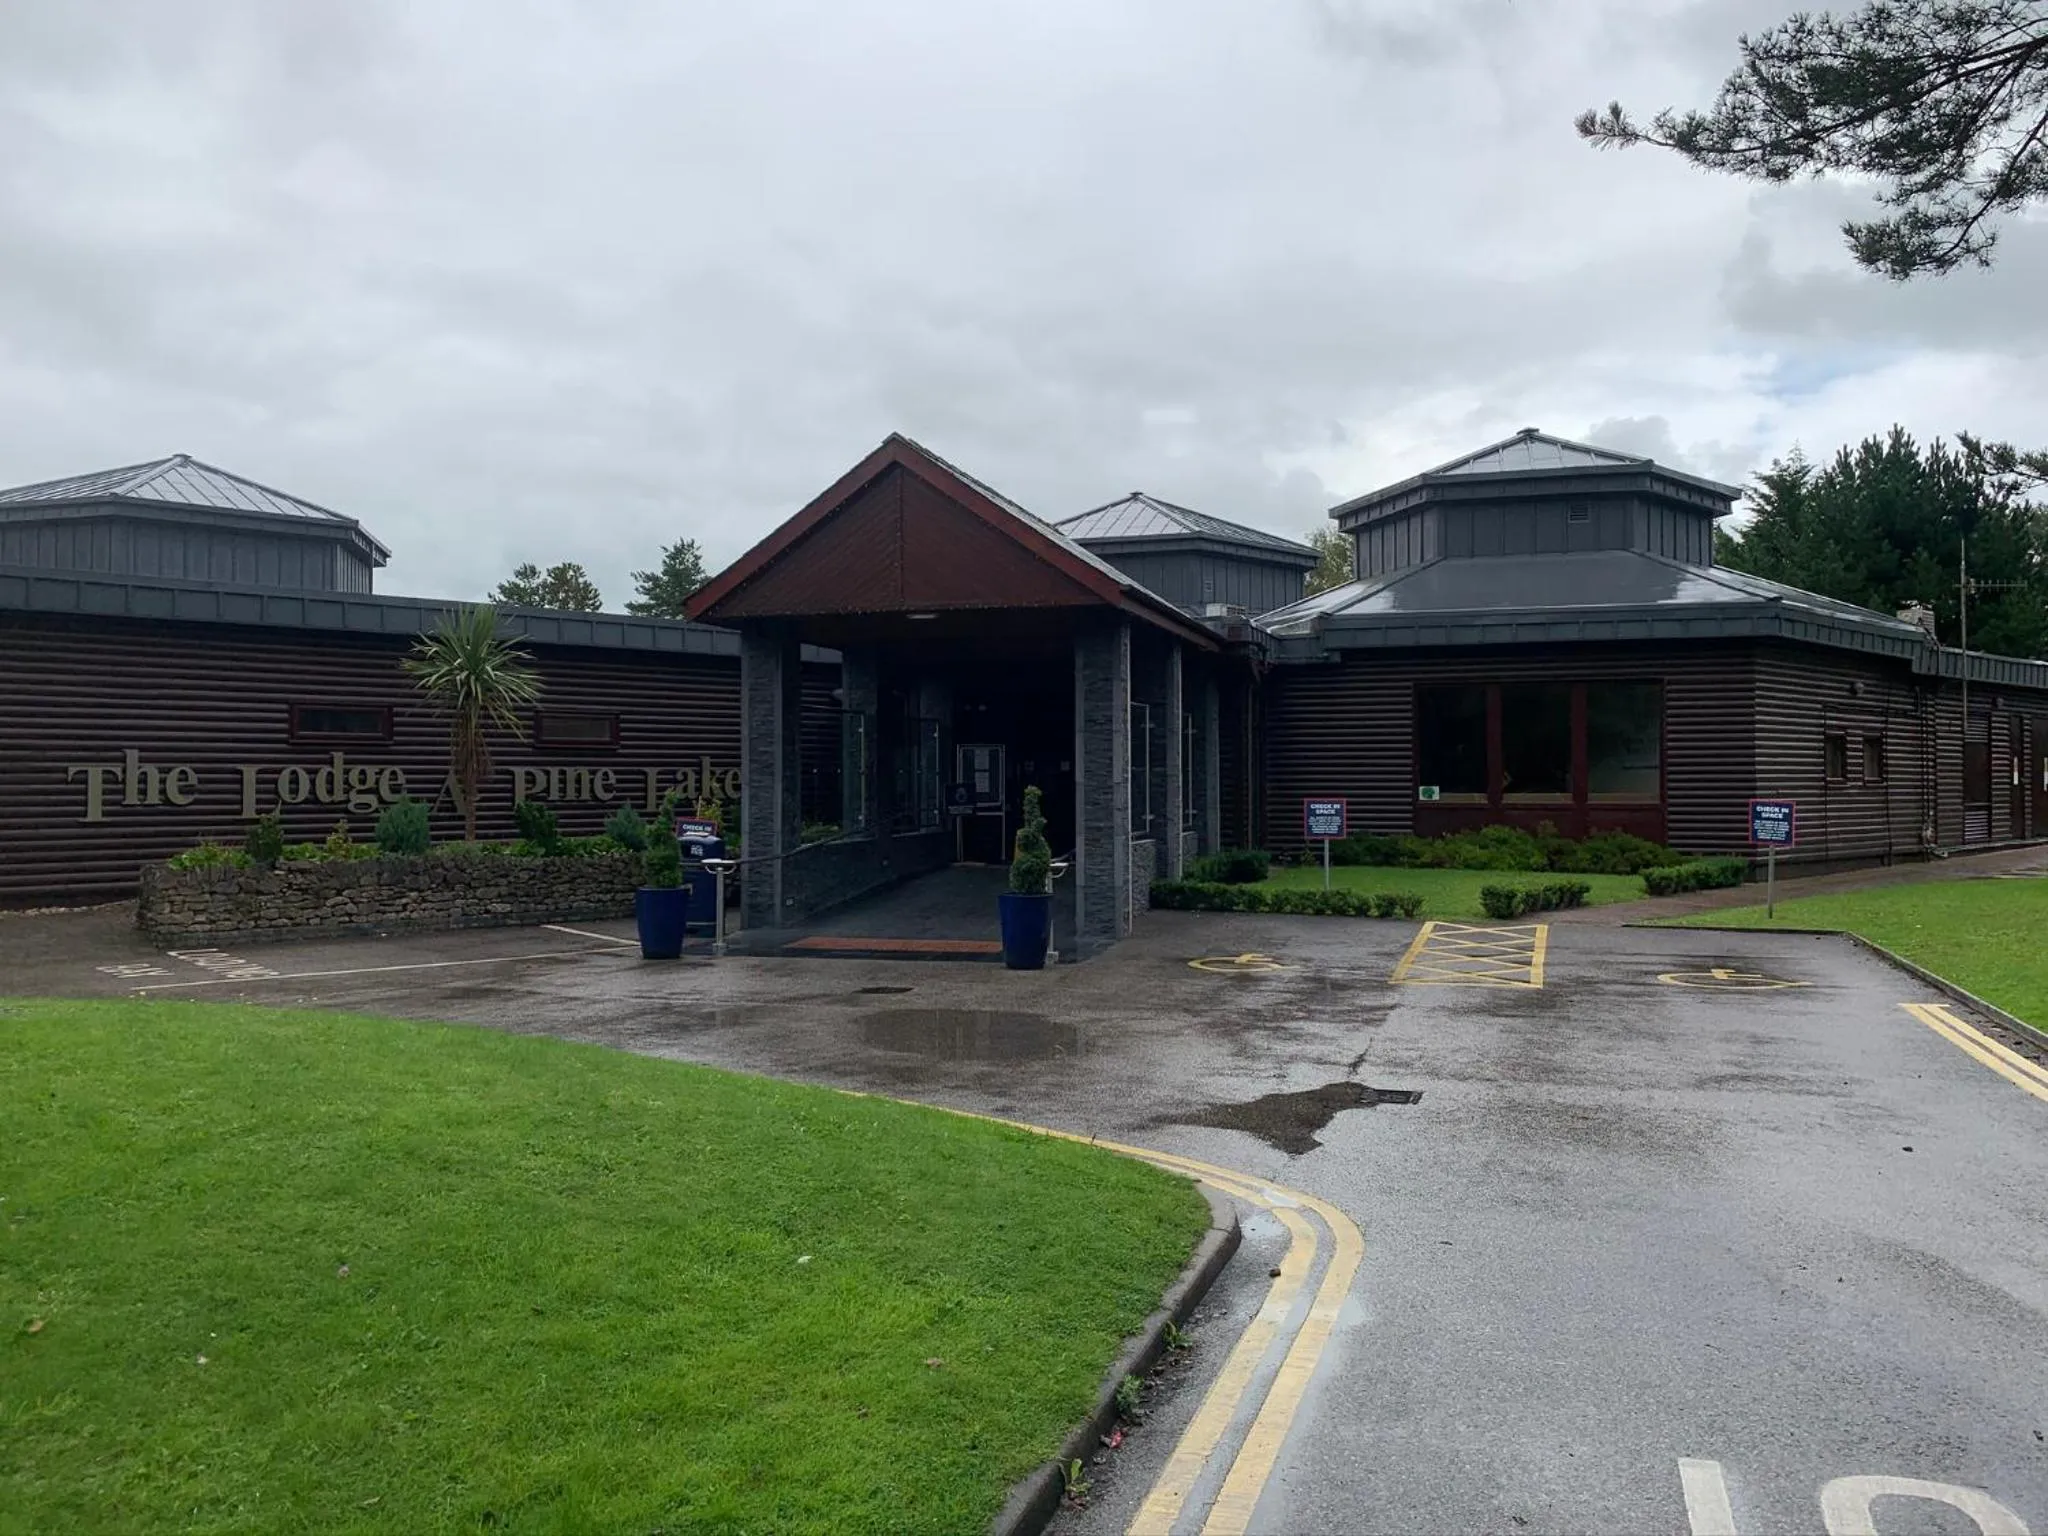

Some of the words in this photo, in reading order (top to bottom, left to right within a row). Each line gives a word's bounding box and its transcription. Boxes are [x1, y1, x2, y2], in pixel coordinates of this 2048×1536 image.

[67, 748, 199, 823] The
[238, 751, 407, 819] Lodge
[430, 765, 481, 814] A
[511, 765, 617, 809] Pine
[641, 755, 742, 812] Lake
